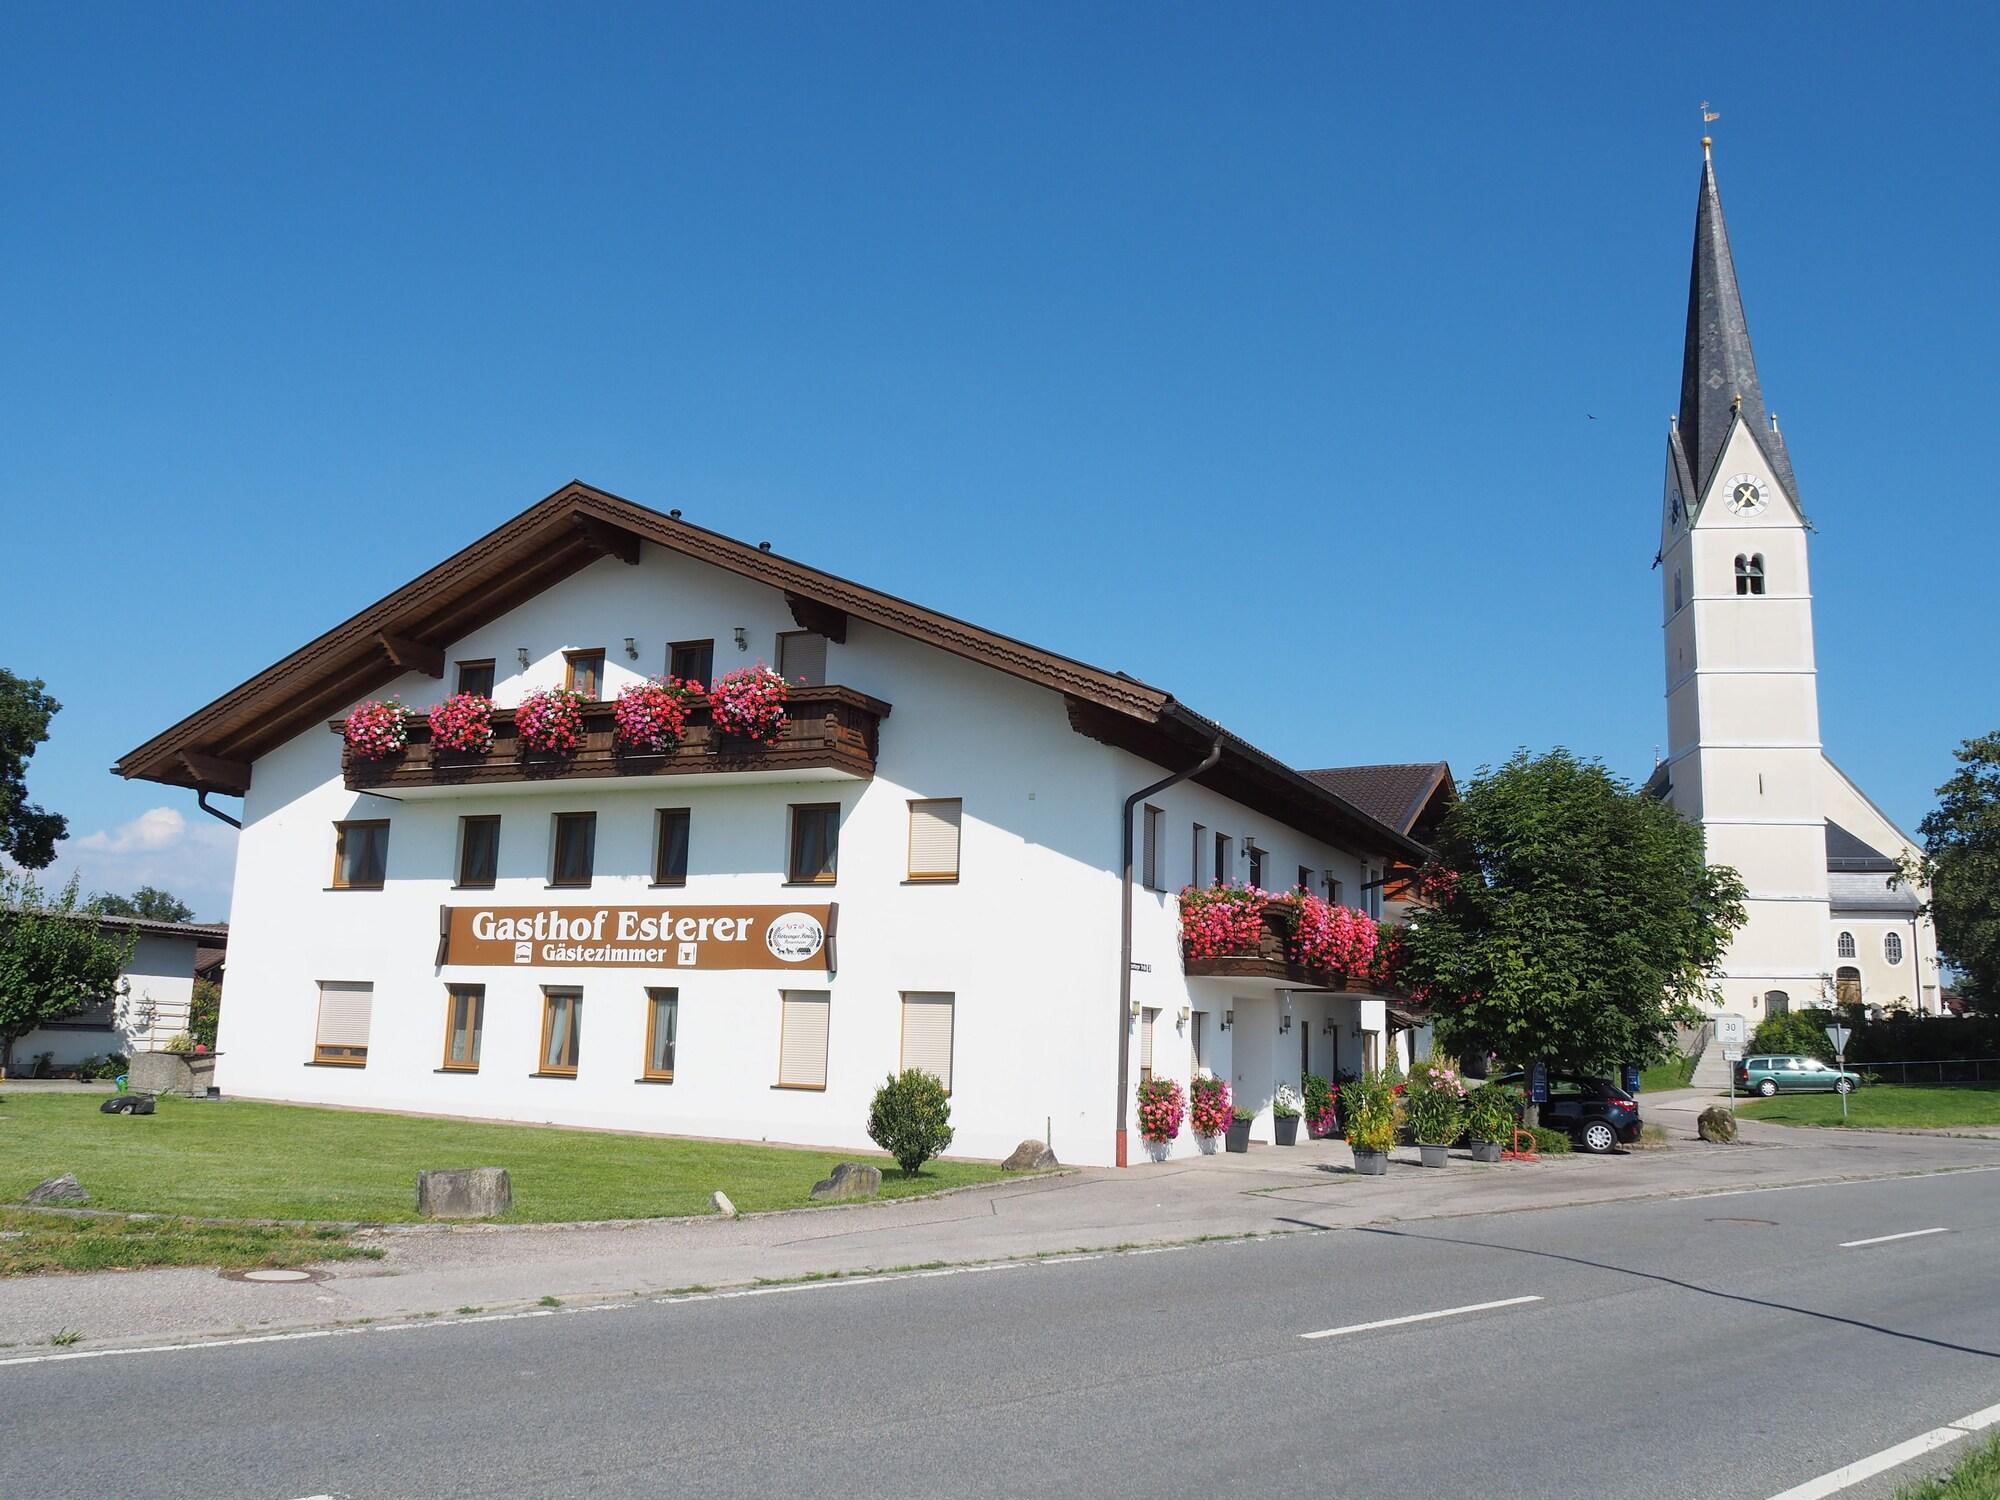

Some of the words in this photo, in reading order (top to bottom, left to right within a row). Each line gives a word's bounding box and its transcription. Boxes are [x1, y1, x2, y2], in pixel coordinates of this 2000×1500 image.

[472, 910, 609, 941] Gasthof
[615, 910, 754, 942] Esterer
[542, 943, 667, 962] Gästezimmer
[1725, 1023, 1736, 1031] 30
